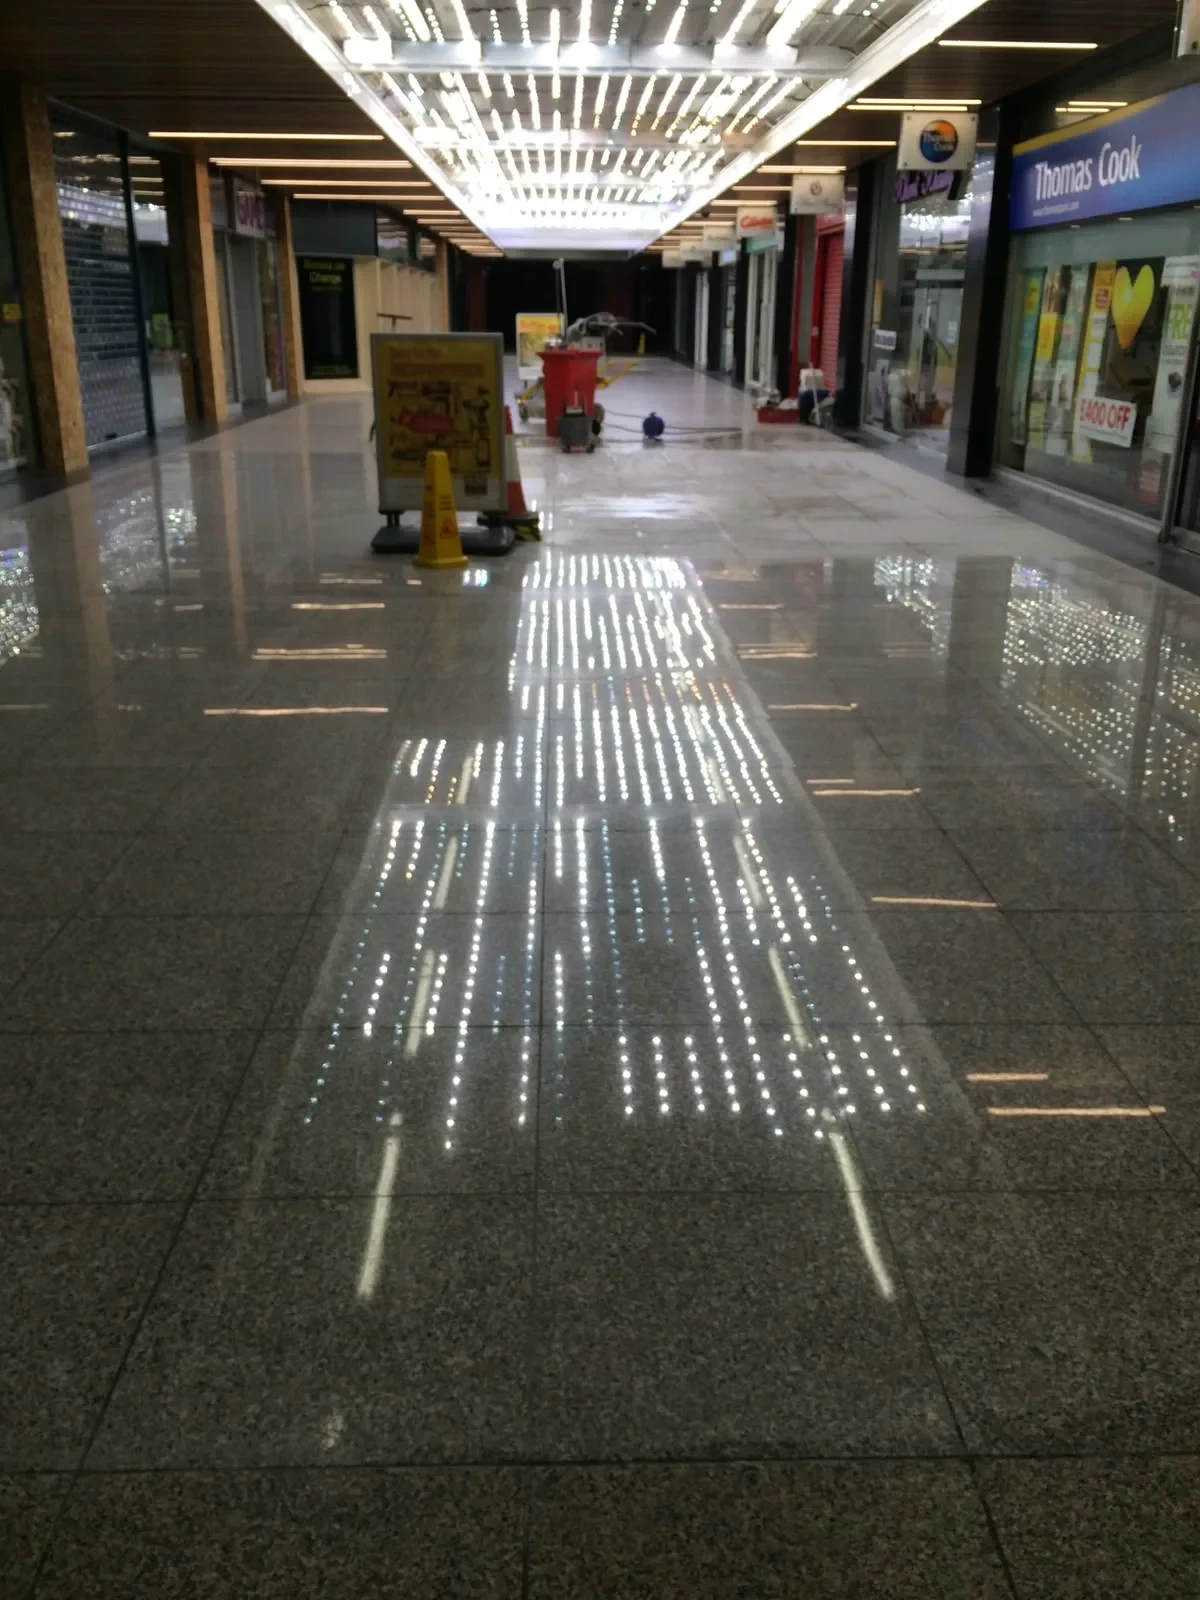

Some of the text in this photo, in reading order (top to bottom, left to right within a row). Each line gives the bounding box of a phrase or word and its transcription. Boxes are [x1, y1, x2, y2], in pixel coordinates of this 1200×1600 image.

[922, 130, 957, 143] Thomas
[934, 141, 955, 152] Cook
[1035, 133, 1142, 201] Thomas Cook
[1107, 403, 1131, 431] OFF
